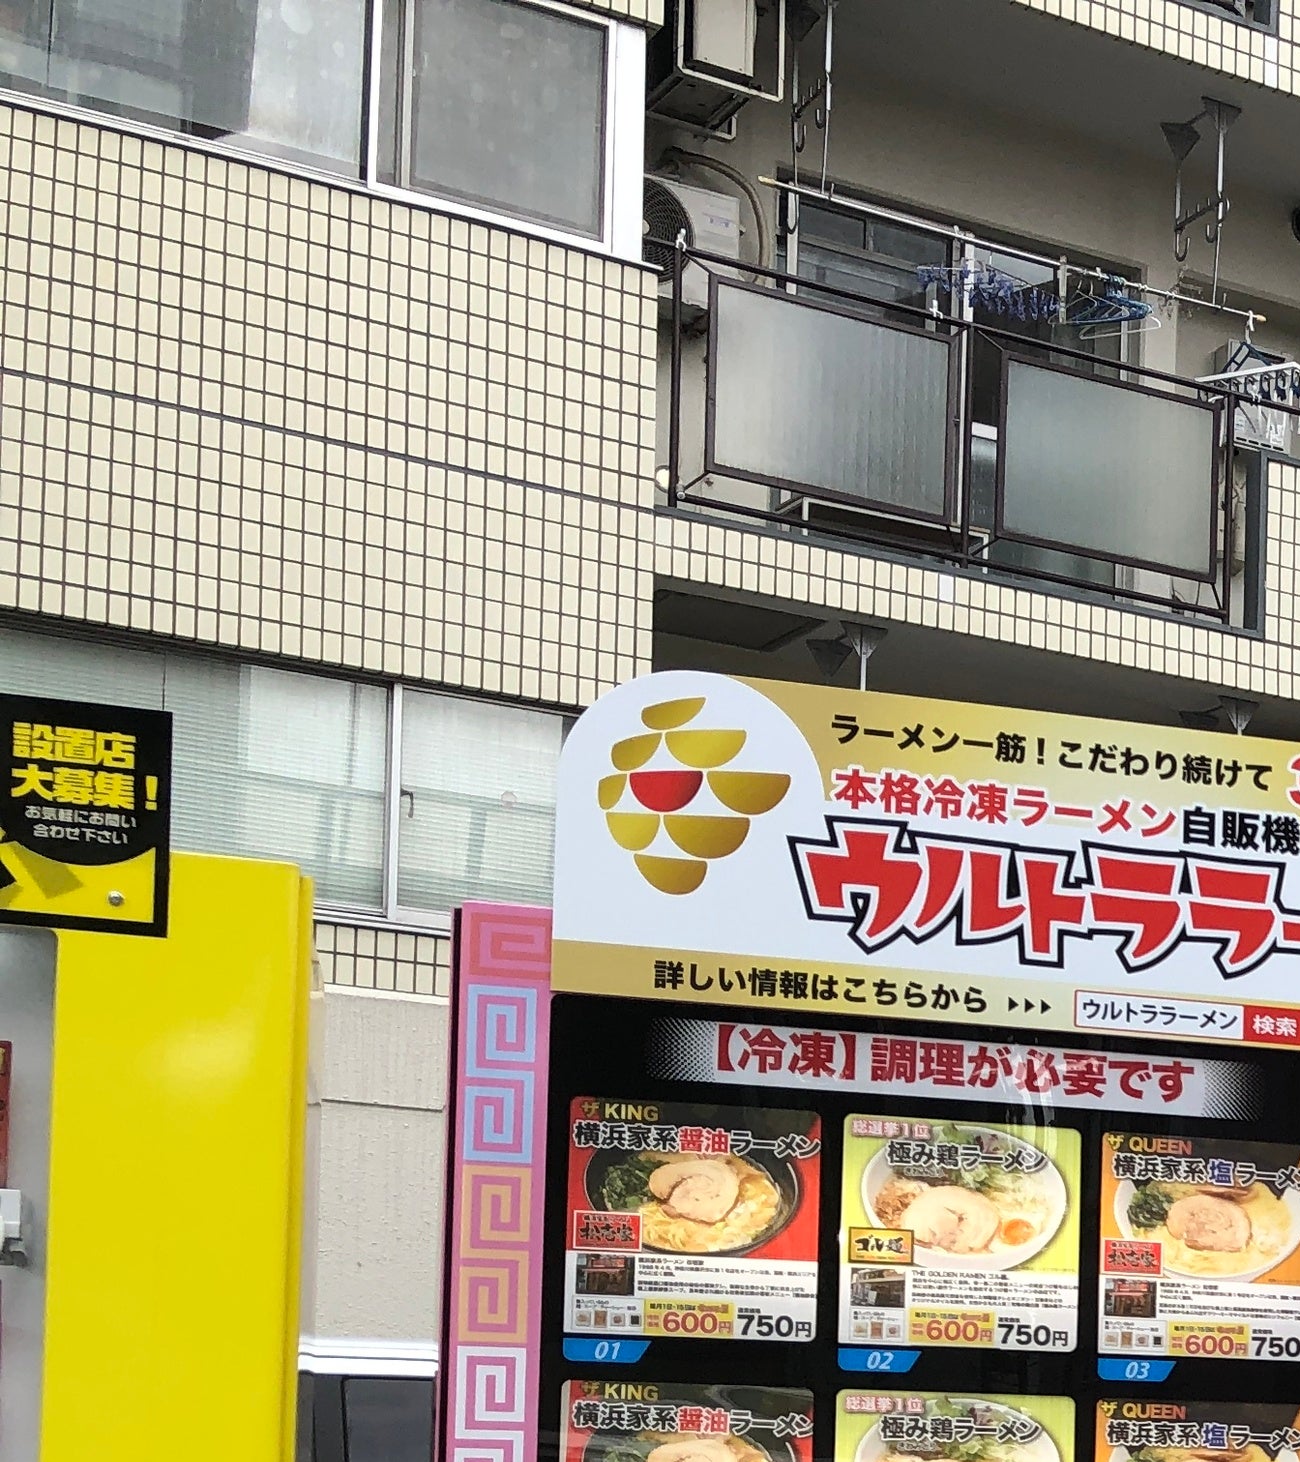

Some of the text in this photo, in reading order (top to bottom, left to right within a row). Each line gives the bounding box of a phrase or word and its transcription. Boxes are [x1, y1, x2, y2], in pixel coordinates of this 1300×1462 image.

[12, 721, 136, 769] 設置店
[25, 805, 136, 828] お気軽にお問い
[834, 769, 1300, 857] 本格冷凍ラーメン自販機
[33, 824, 128, 844] 合わせ下さい
[654, 960, 988, 1013] 詳しい情報はこちらから
[1082, 998, 1299, 1038] ウルトララーメン 検索
[712, 1022, 1196, 1101] 【冷凍】調理が必要です
[604, 1103, 659, 1121] KING
[573, 1119, 821, 1159] 横浜家系醤油ラーメン
[1129, 1137, 1192, 1155] QUEEN
[887, 1141, 1048, 1172] 極み鶏ラーメン
[663, 1311, 812, 1337] 600円 750円
[926, 1319, 1069, 1347] 600円 750円
[595, 1343, 621, 1361] 01
[1185, 1334, 1248, 1356] 600円
[867, 1352, 891, 1370] 02
[1125, 1362, 1150, 1380] 03
[604, 1383, 659, 1401] KING
[572, 1401, 813, 1438] 横浜家系醤油ラーメン
[1123, 1403, 1186, 1419] QUEEN
[880, 1415, 1042, 1443] 極み鶏ラーメン
